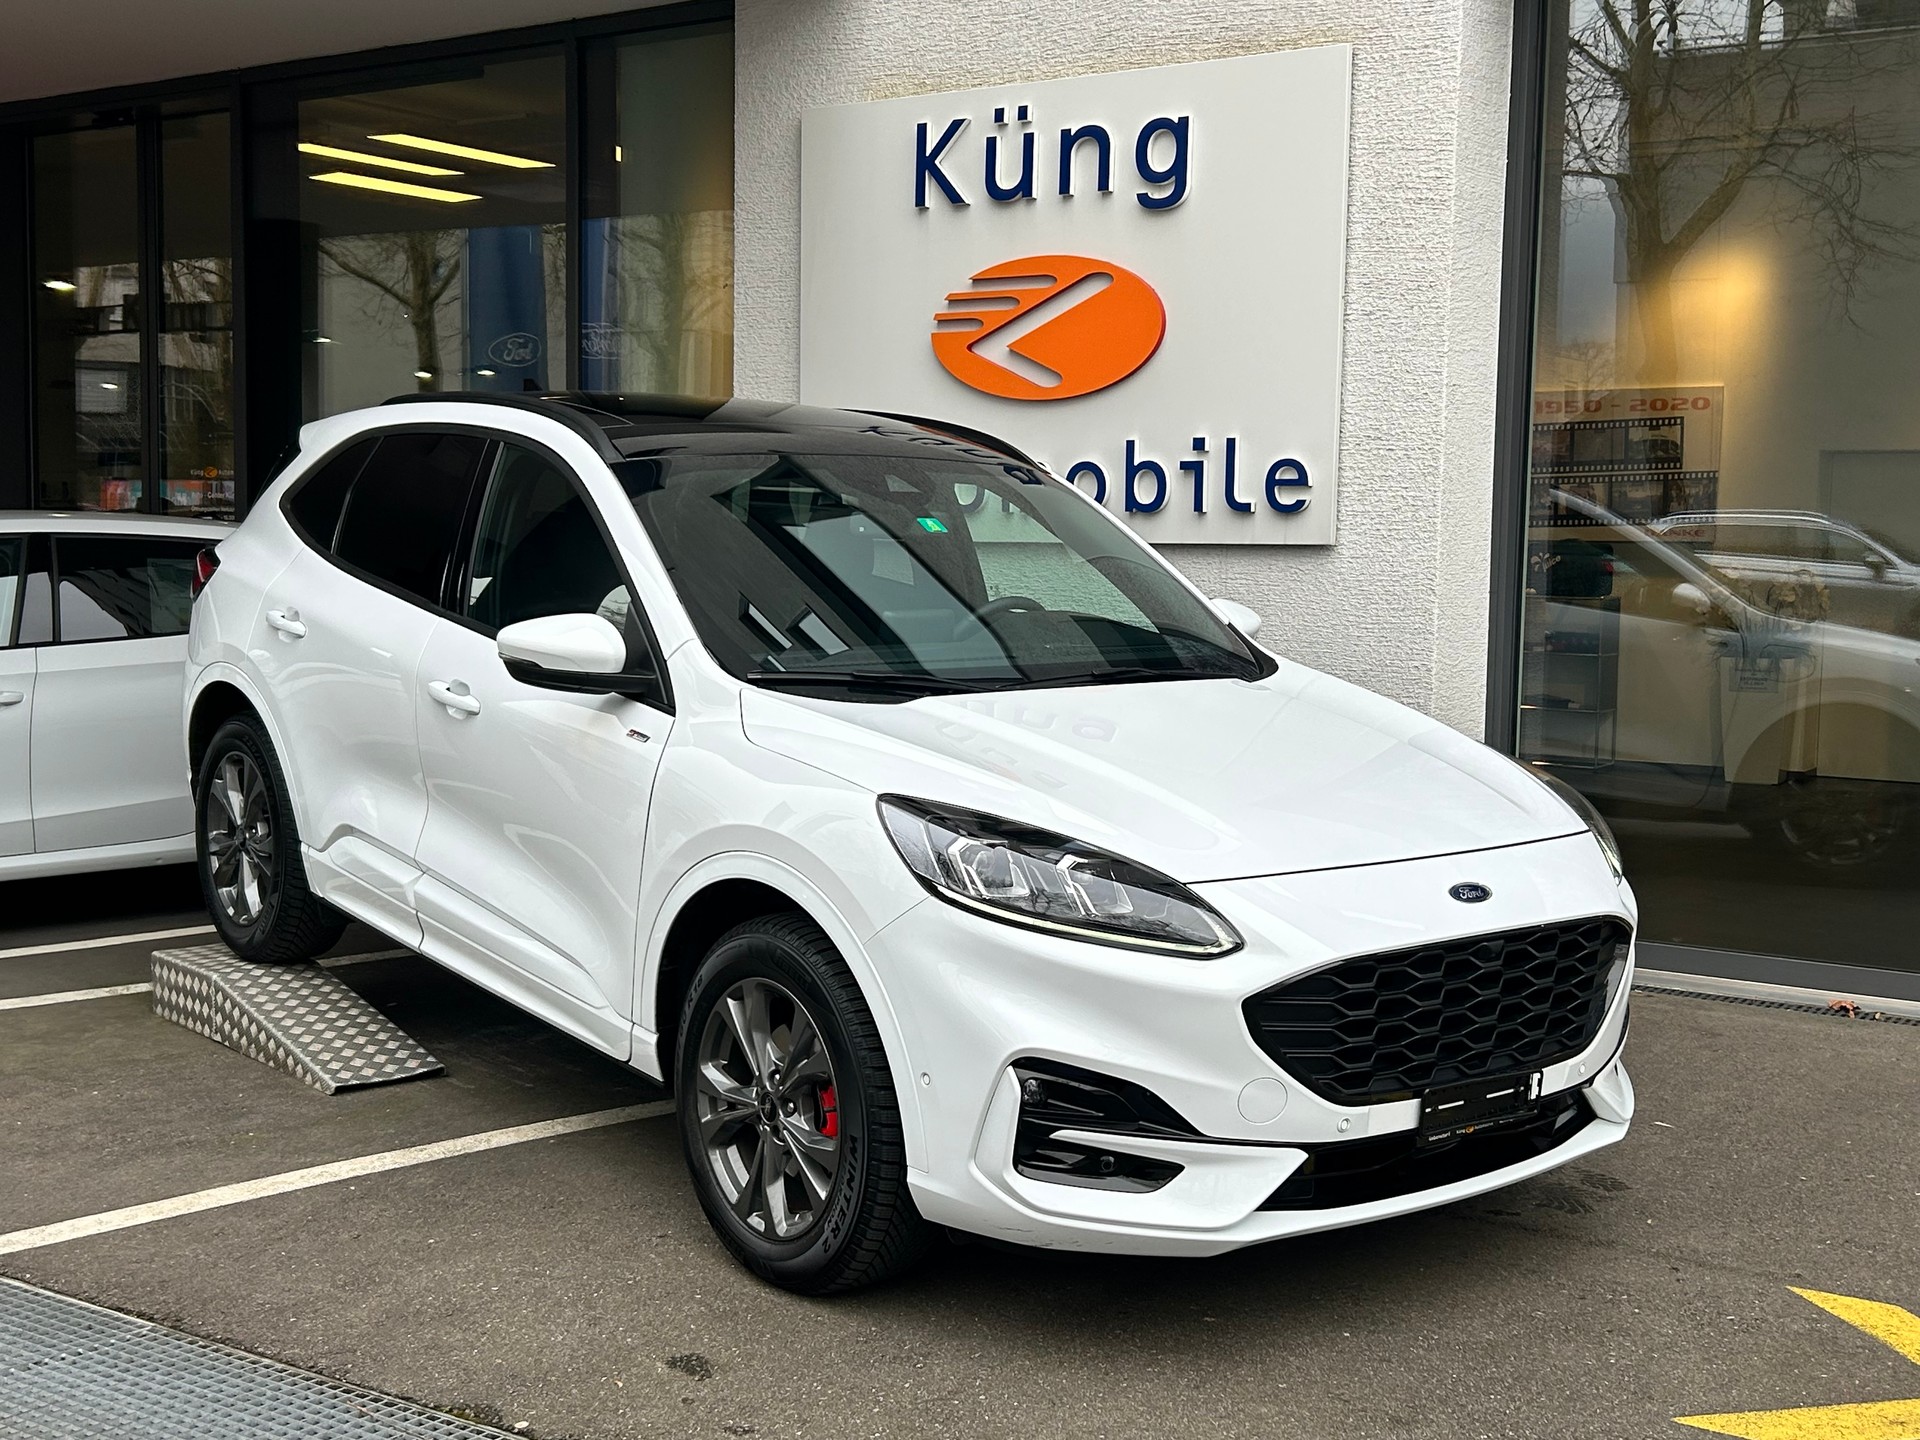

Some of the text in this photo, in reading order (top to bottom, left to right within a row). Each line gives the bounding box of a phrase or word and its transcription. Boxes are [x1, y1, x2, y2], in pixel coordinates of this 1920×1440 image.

[914, 103, 1195, 211] Küng
[1629, 397, 1711, 412] 2020
[1036, 436, 1314, 516] obile
[1458, 886, 1485, 899] Ford
[822, 1134, 858, 1253] WINTER 2
